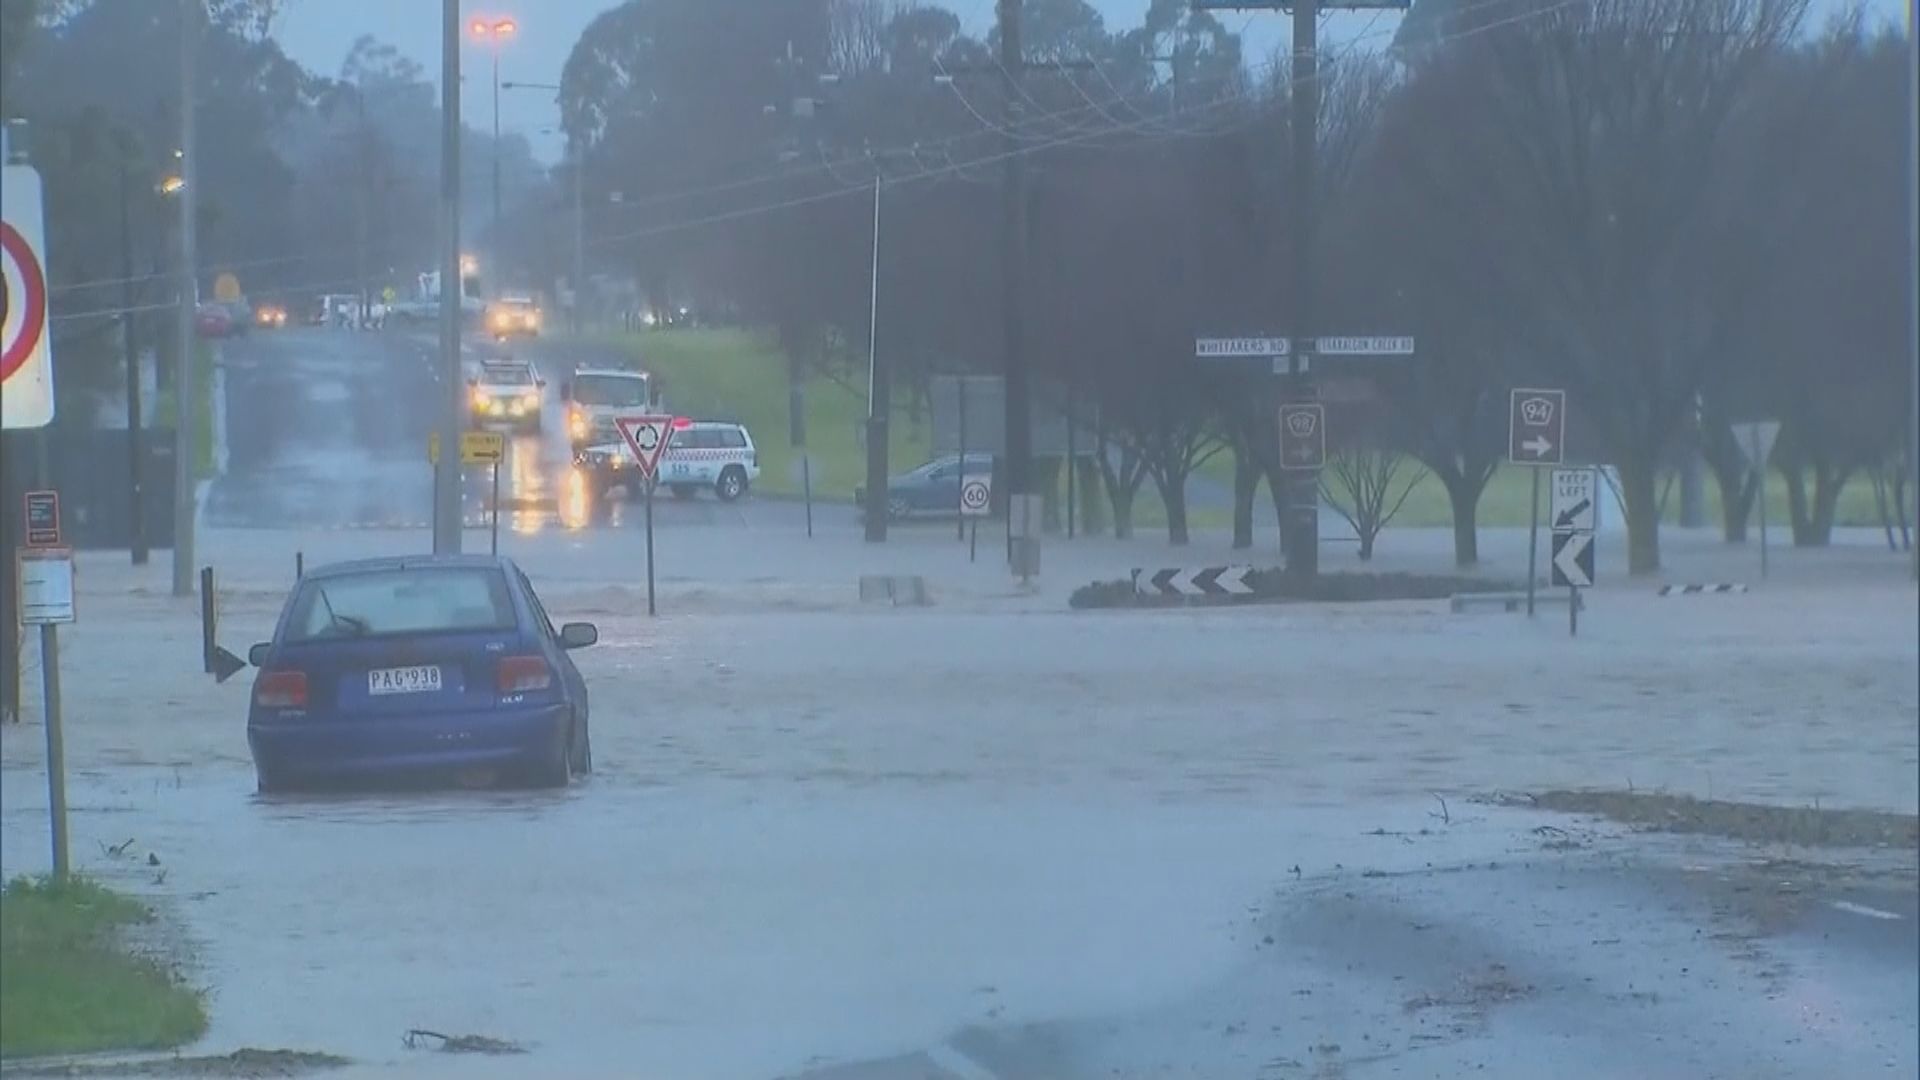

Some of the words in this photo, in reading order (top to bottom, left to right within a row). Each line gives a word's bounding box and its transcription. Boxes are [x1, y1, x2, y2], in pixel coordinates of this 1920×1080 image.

[1526, 404, 1547, 419] 94
[1558, 473, 1590, 482] KEEP
[967, 488, 985, 502] 60
[1559, 486, 1588, 497] LEFT
